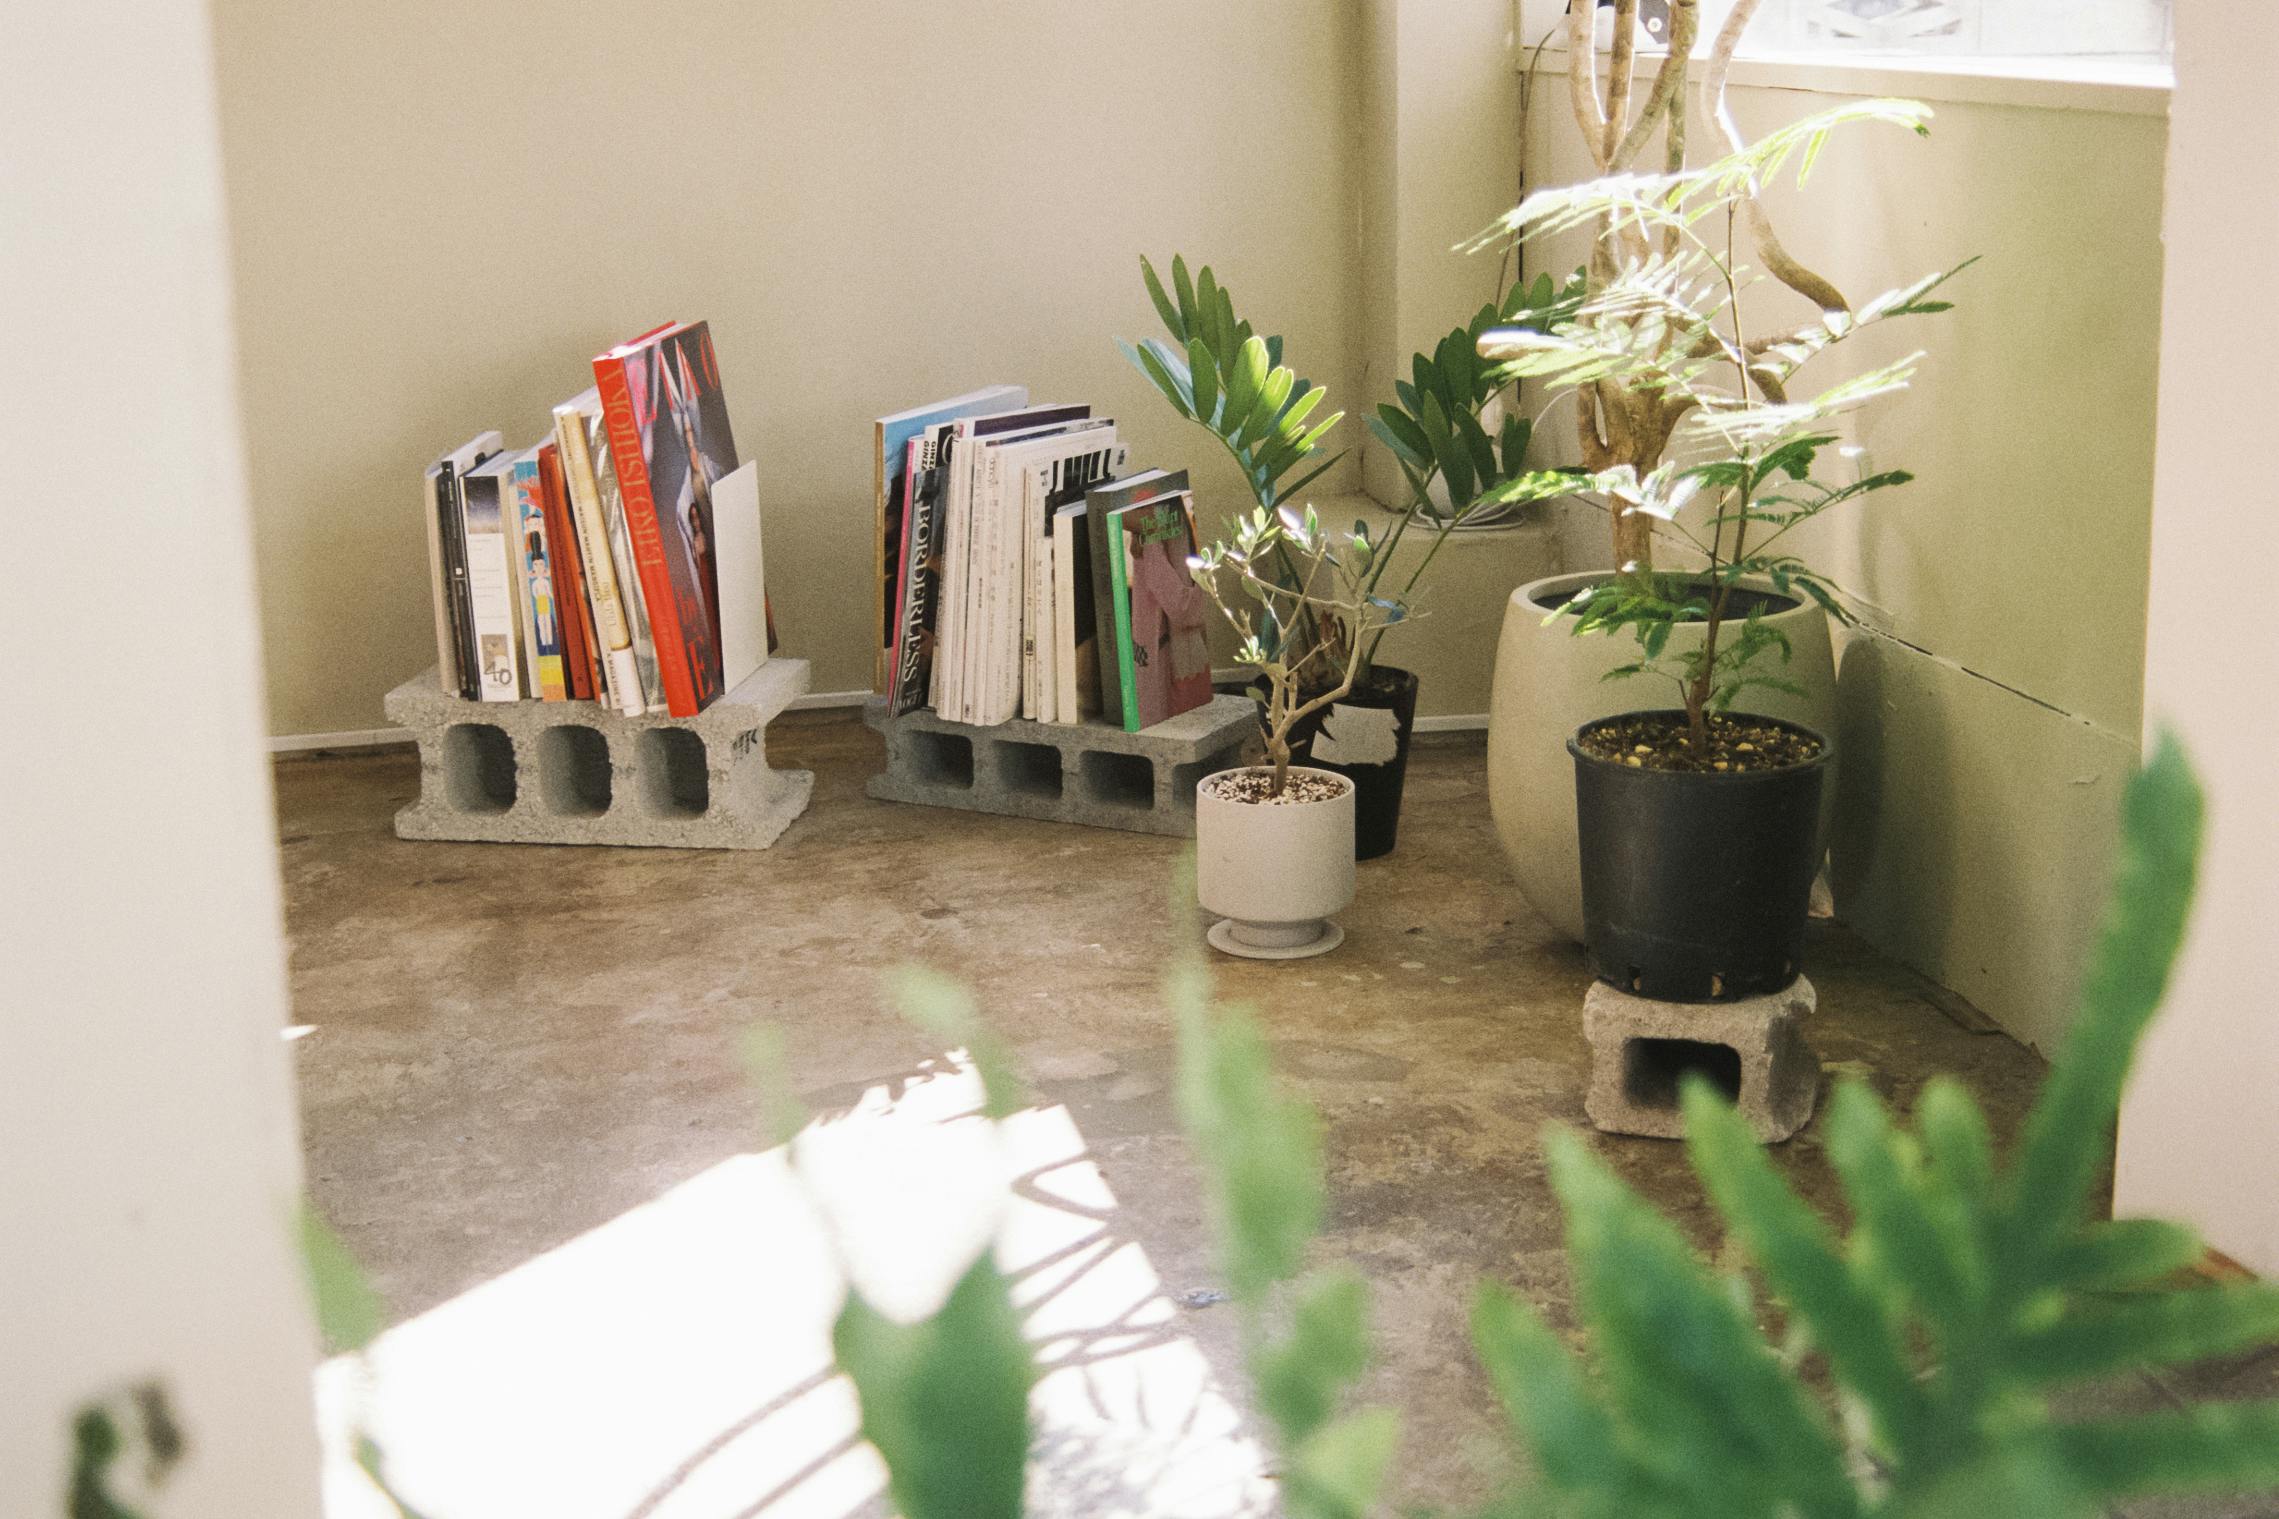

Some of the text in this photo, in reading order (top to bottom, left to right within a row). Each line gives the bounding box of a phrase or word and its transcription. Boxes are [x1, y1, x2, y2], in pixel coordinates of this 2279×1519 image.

[929, 440, 937, 470] GINZ
[904, 504, 931, 682] BORDERLESS
[484, 661, 513, 686] 40
